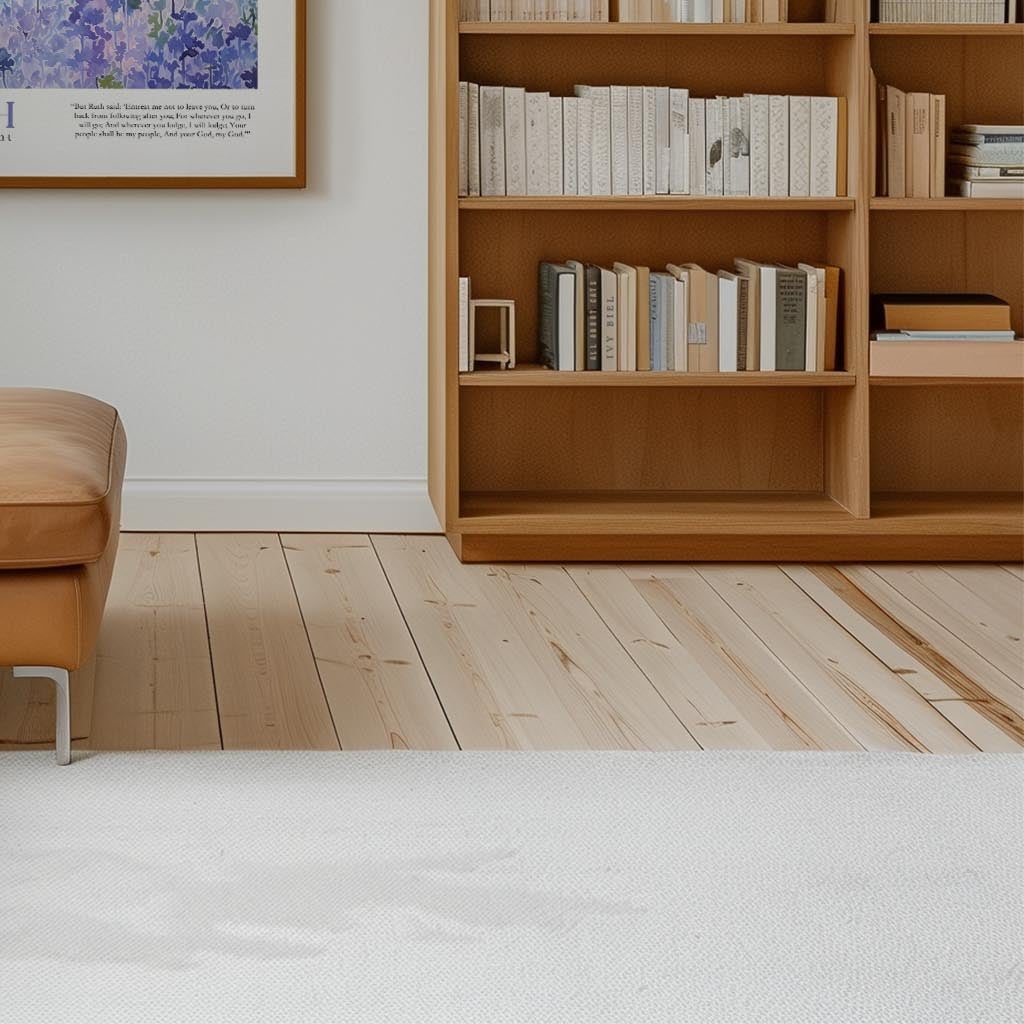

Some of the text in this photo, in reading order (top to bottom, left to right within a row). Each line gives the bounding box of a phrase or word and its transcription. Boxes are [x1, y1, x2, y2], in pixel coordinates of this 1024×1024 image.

[110, 113, 141, 121] following
[222, 113, 234, 121] you
[153, 122, 165, 130] you
[74, 131, 97, 139] people
[126, 131, 136, 139] my
[180, 131, 195, 139] your
[216, 131, 226, 139] my
[606, 296, 614, 359] IVY BIEL
